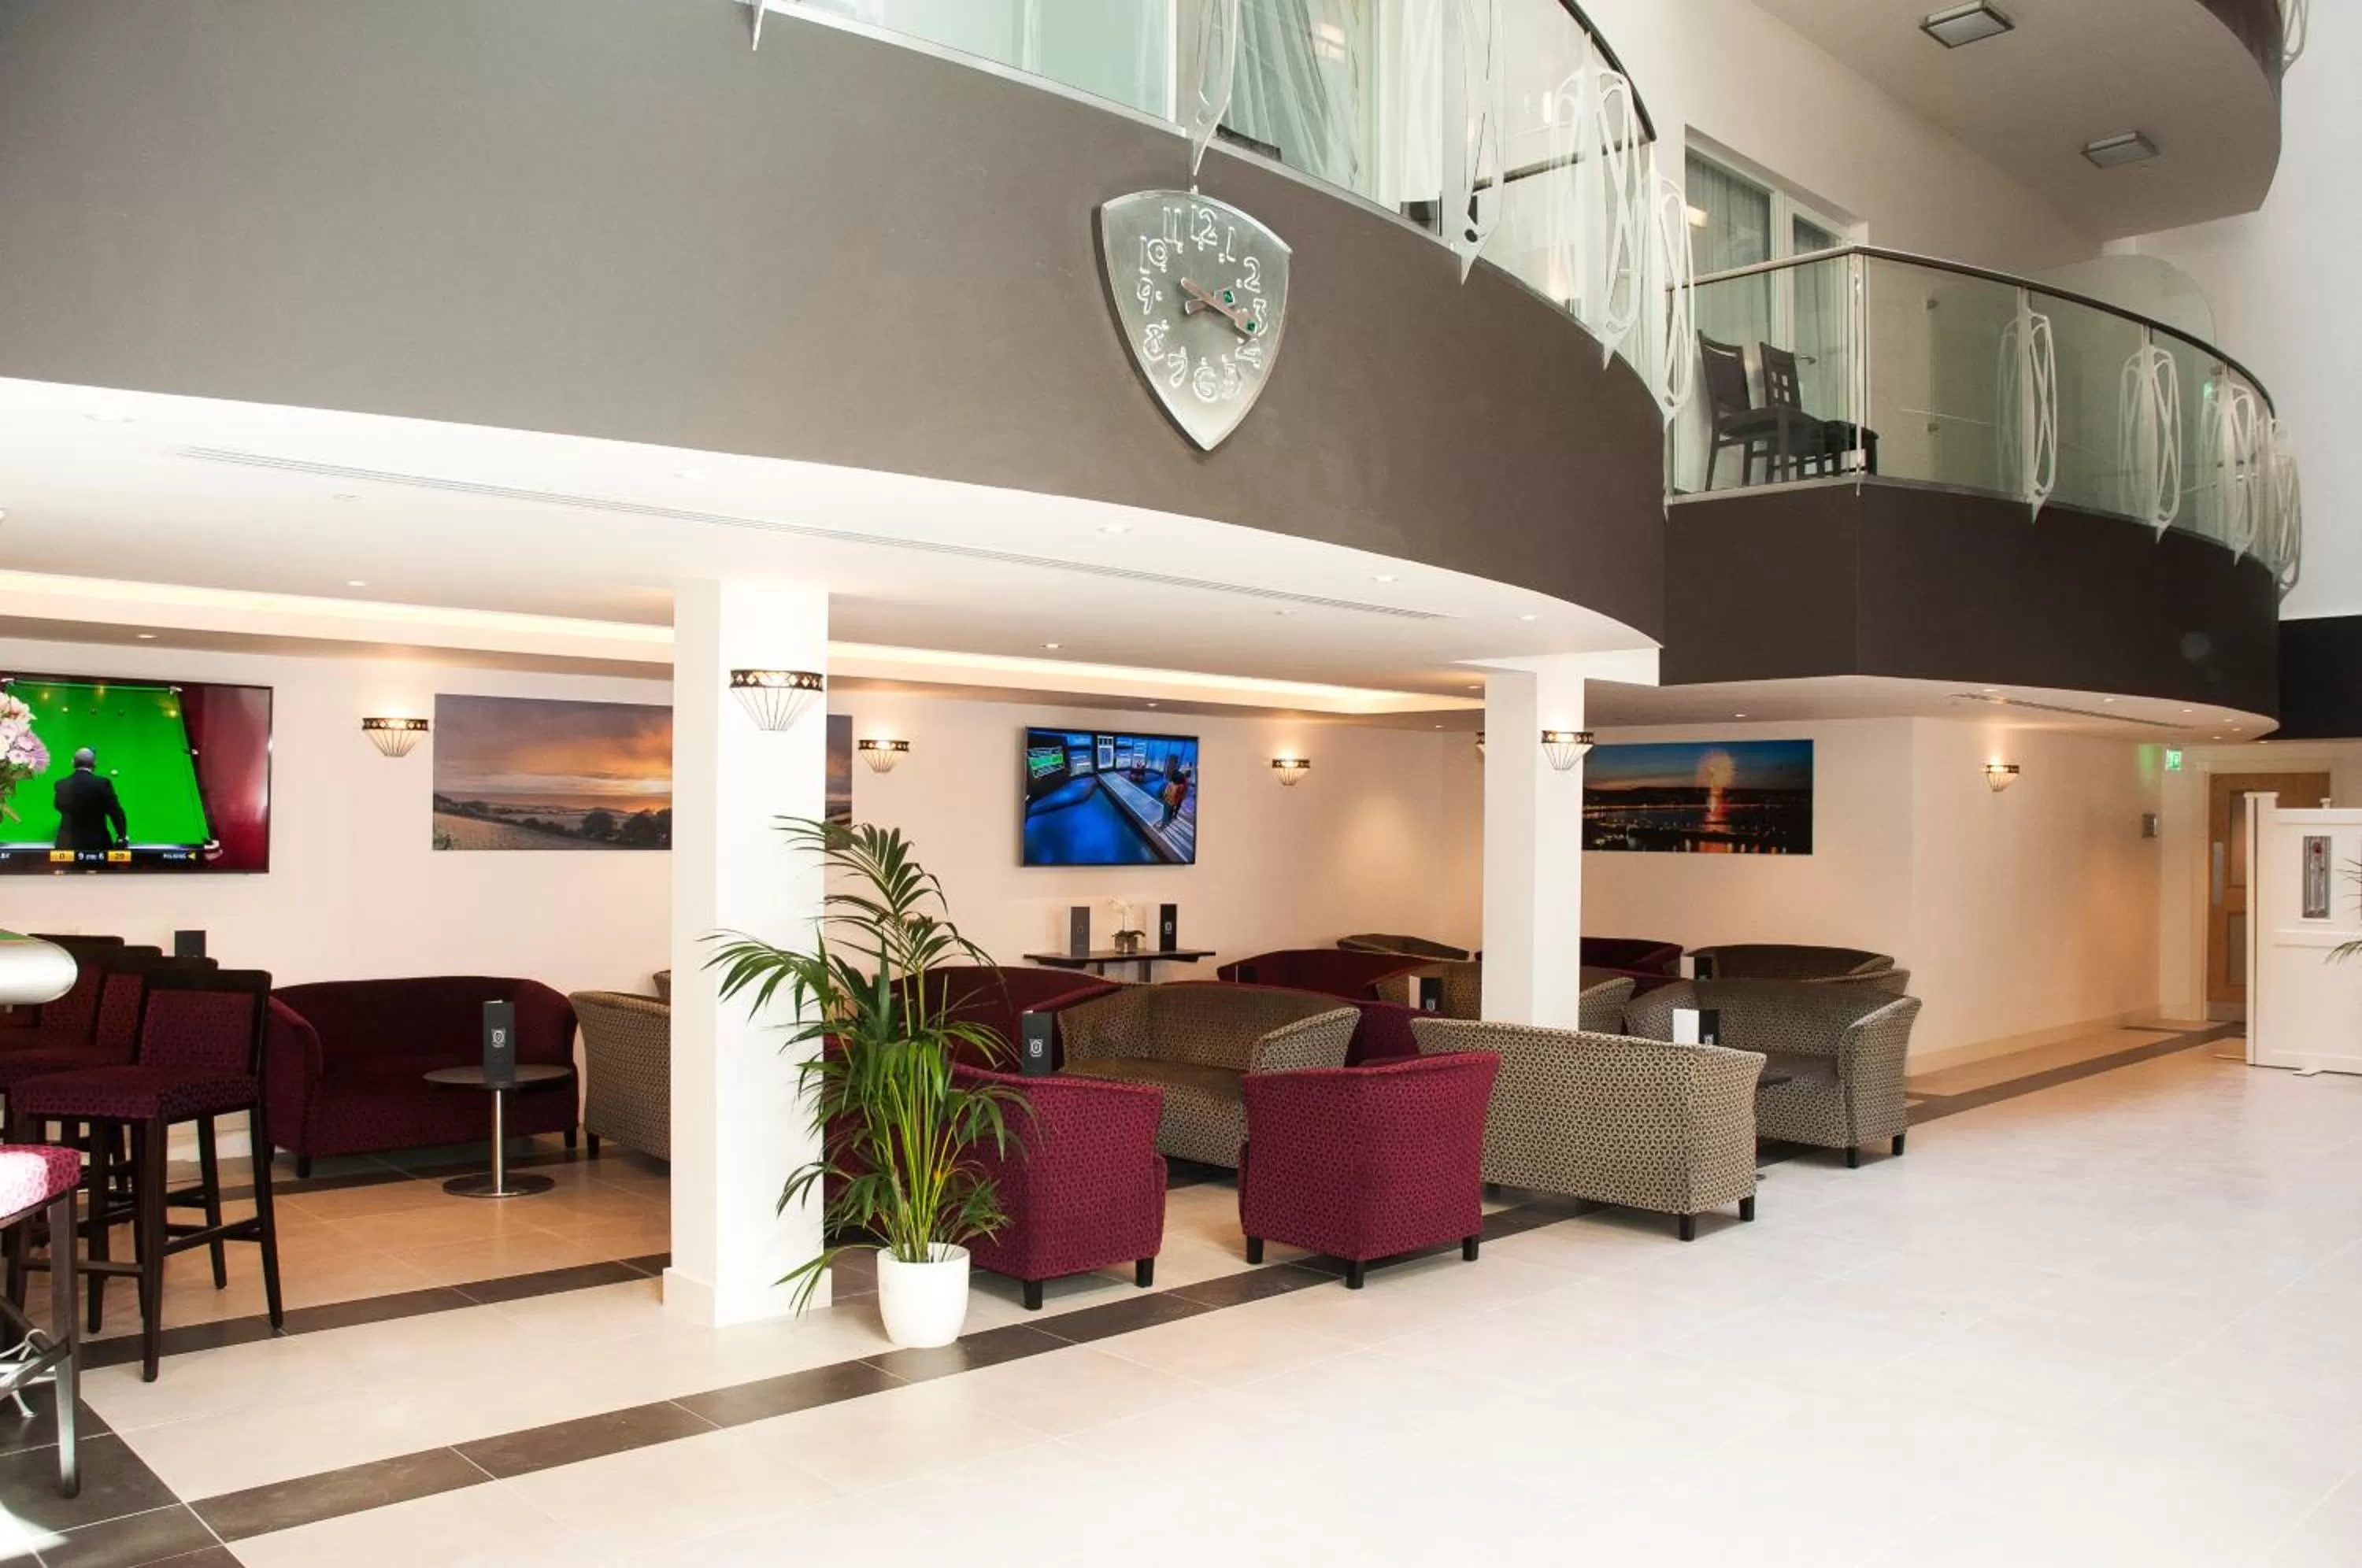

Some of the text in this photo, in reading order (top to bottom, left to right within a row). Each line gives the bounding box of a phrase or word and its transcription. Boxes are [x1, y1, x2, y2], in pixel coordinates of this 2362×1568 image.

[1190, 205, 1218, 246] 12
[1140, 235, 1168, 274] 10
[1243, 256, 1261, 292] 2
[1137, 277, 1154, 314] 9
[1251, 298, 1268, 337] 3
[1142, 324, 1165, 361] 8
[1168, 353, 1188, 388] 7
[1192, 366, 1218, 402] 6
